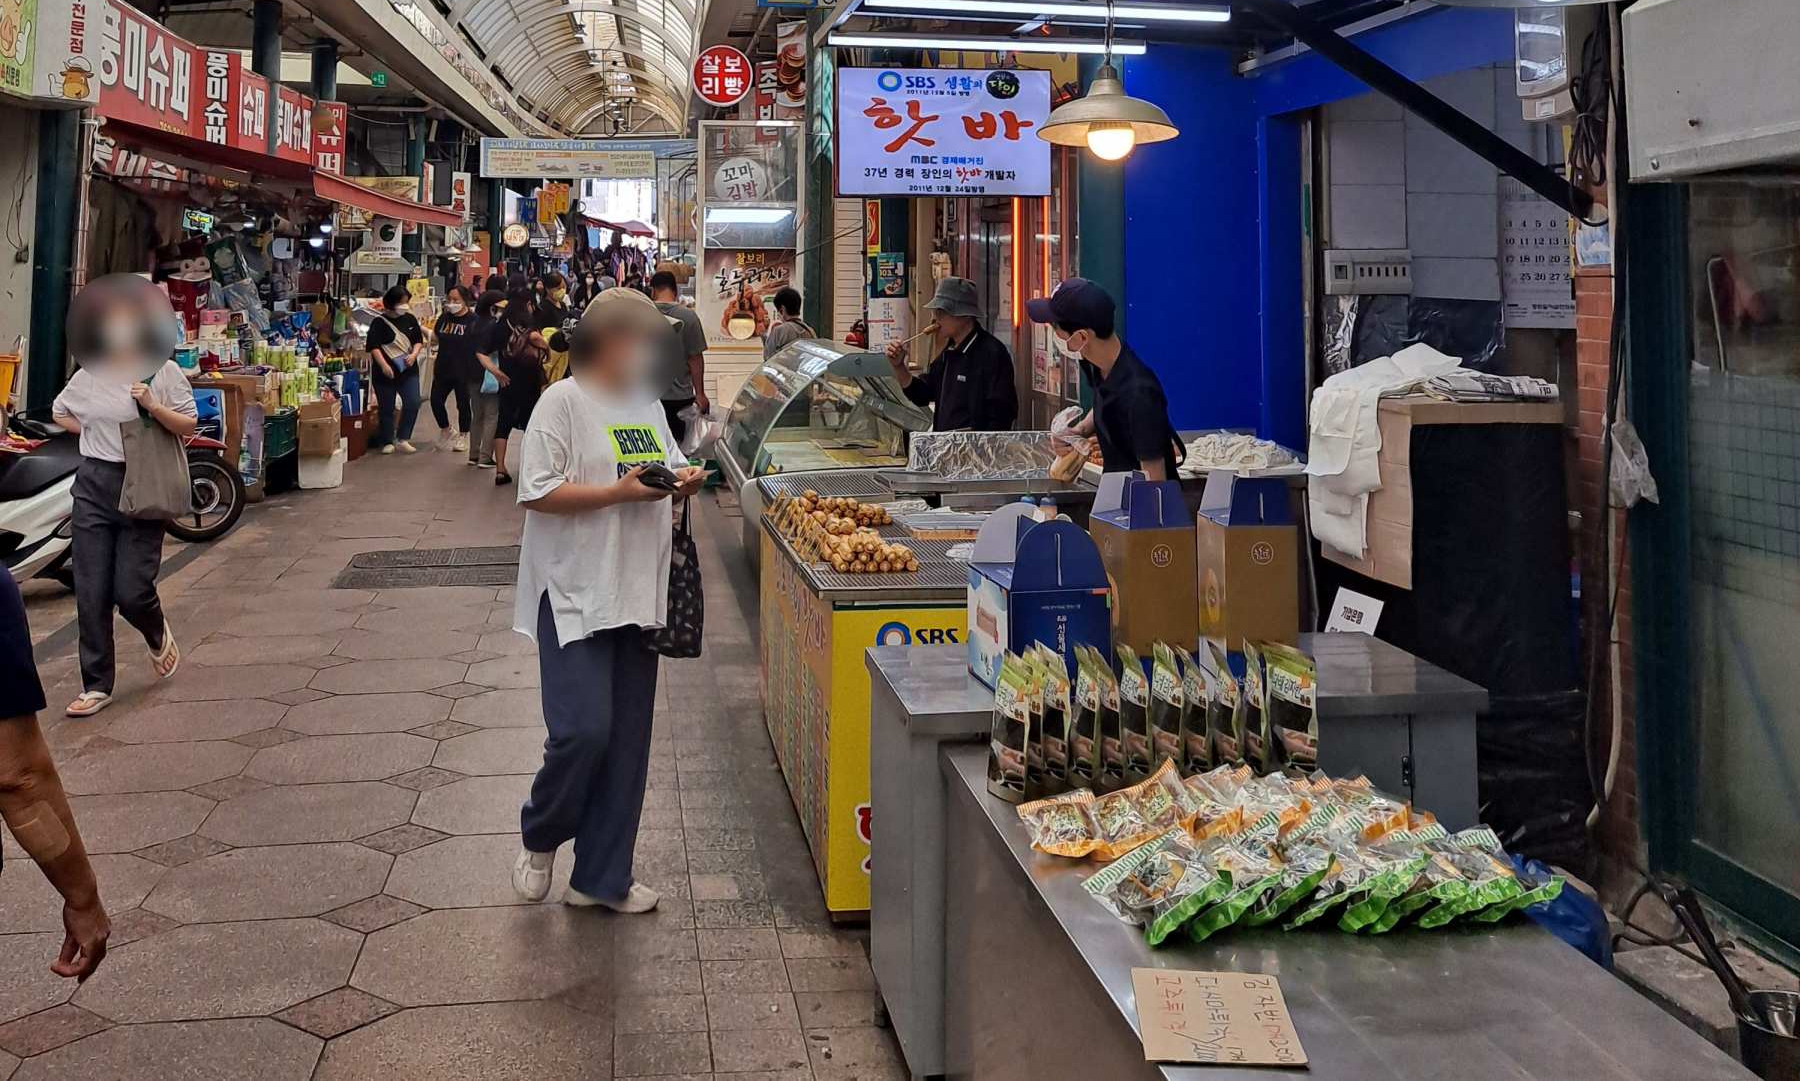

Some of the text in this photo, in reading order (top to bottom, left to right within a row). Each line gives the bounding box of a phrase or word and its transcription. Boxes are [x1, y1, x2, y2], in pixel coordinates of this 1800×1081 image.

[702, 54, 743, 74] 찰보
[702, 76, 744, 96] 리빵
[905, 76, 936, 89] SBS
[944, 76, 983, 91] 생활의
[238, 81, 266, 141] 슈퍼
[863, 97, 1034, 154] 핫 바
[911, 155, 938, 165] MBC
[722, 162, 755, 183] 꼬마
[864, 167, 1016, 184] 37년 경력 장인의 핫바 개발자
[727, 180, 758, 201] 김밥
[909, 184, 933, 192] 2011년
[736, 252, 766, 265] 찰보리
[613, 428, 662, 456] GENERAL
